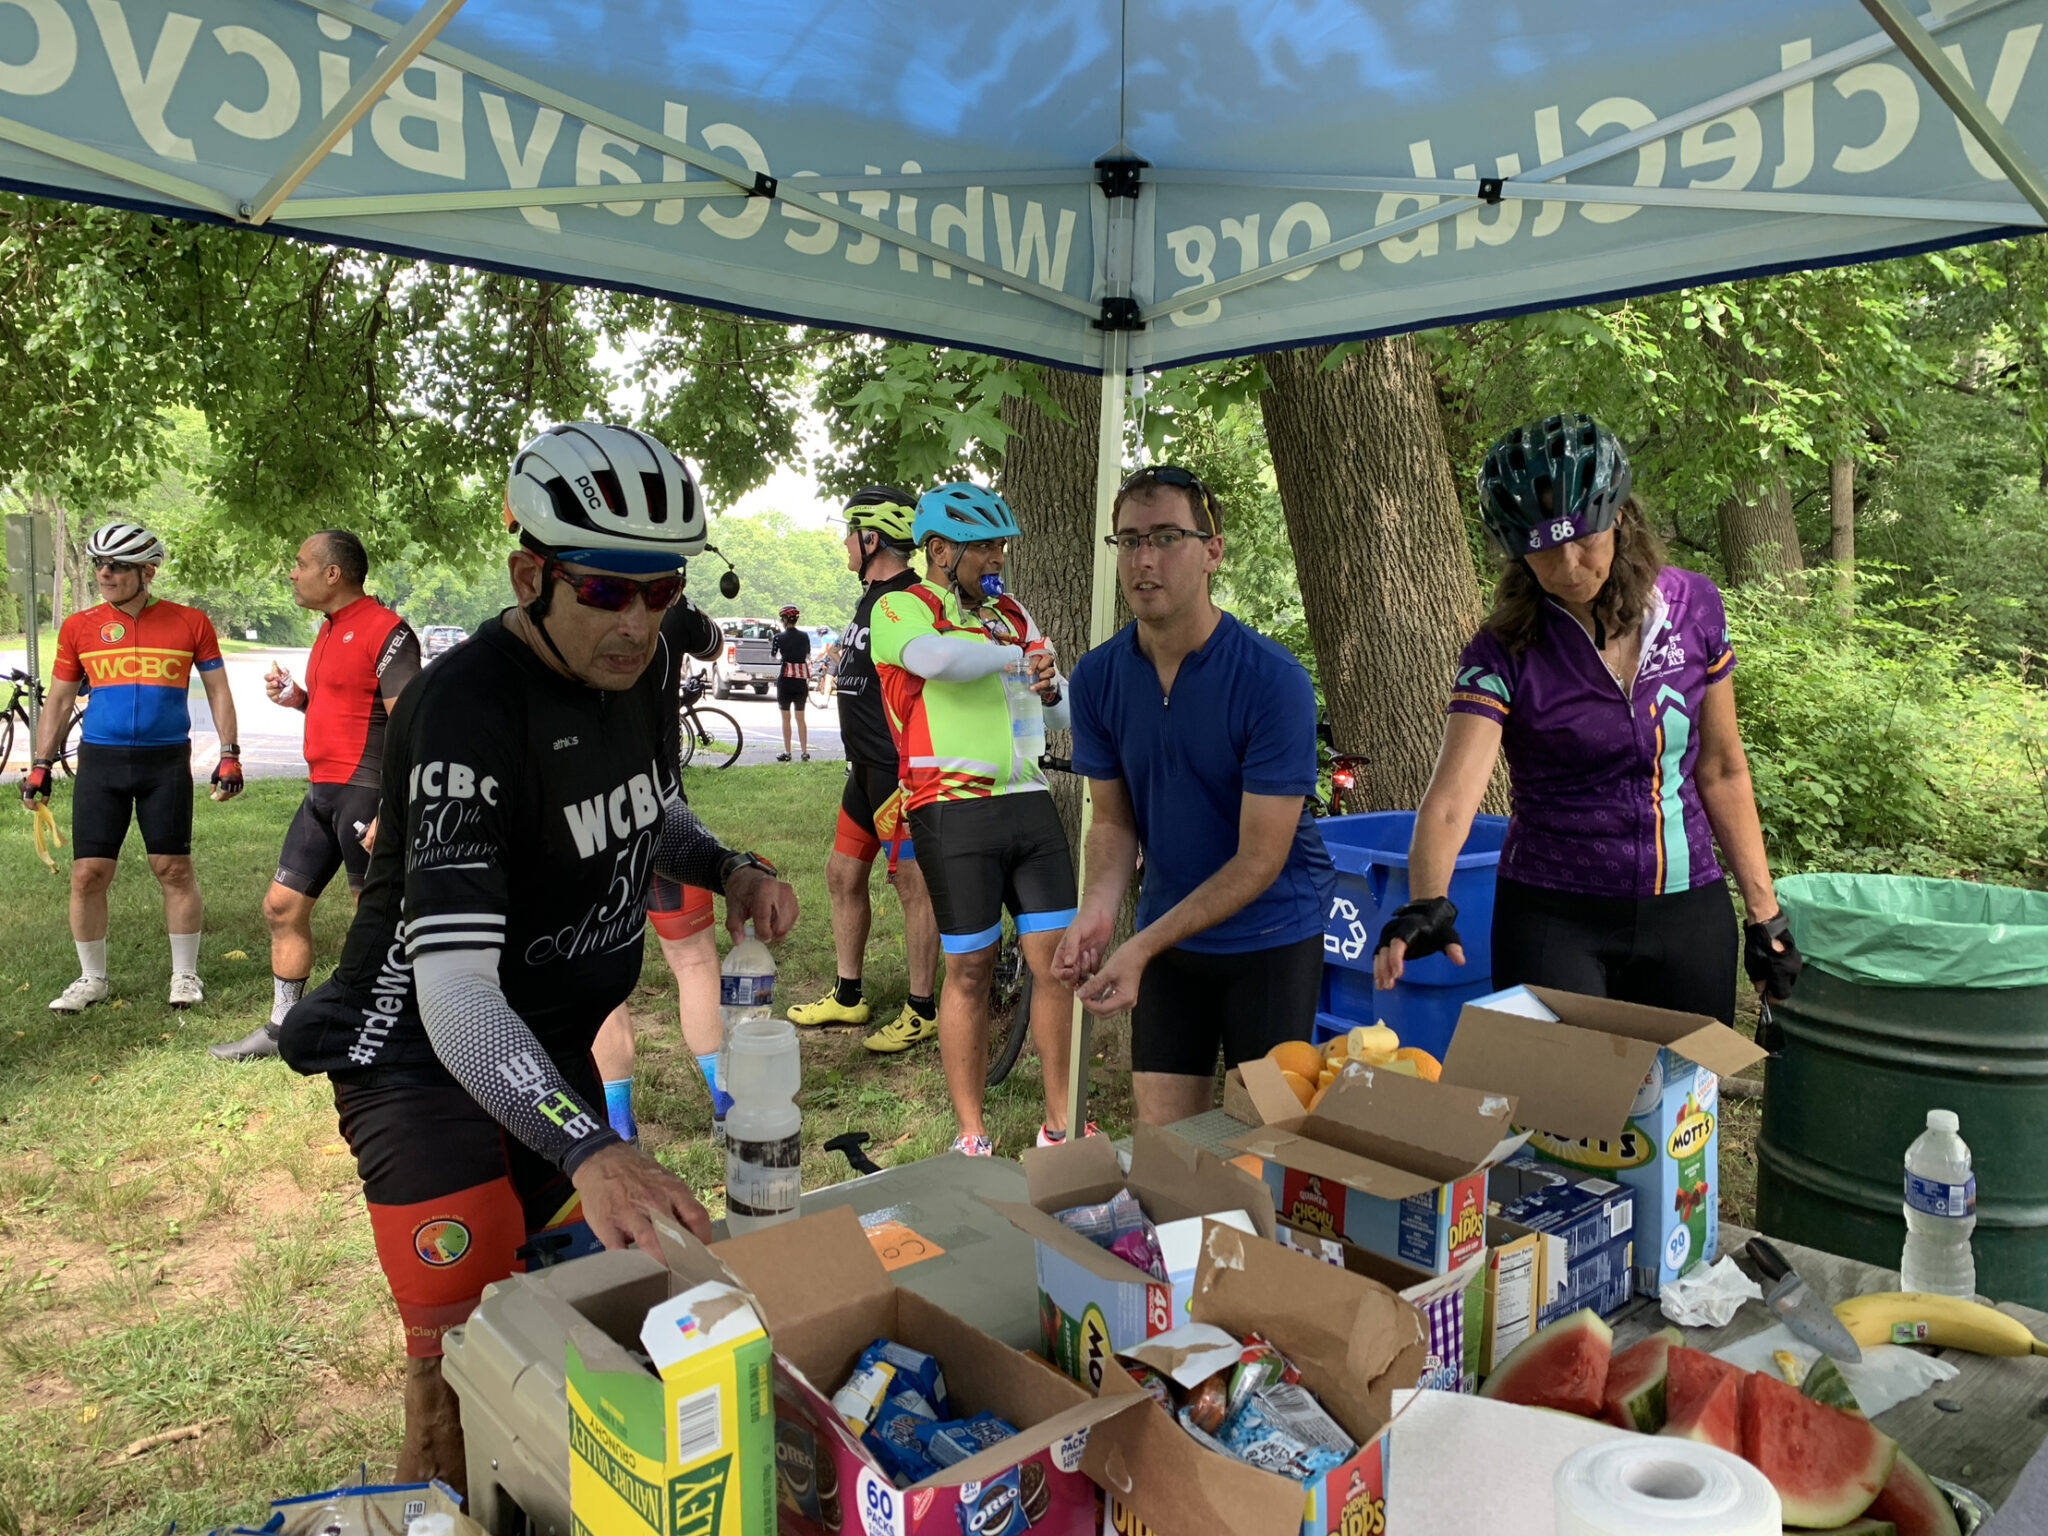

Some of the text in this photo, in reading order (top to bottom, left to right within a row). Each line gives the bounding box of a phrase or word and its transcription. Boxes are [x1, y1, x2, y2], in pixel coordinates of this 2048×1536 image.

[575, 475, 601, 510] POC
[1550, 521, 1575, 541] 86
[91, 656, 182, 680] WCBC
[1667, 648, 1685, 659] END
[1668, 656, 1686, 667] ALZ
[1672, 1119, 1710, 1152] MOTT'S
[1292, 1200, 1334, 1227] CHEWY
[1449, 1213, 1484, 1250] DIPPS
[1671, 1231, 1685, 1254] 90
[1153, 1287, 1168, 1331] 40
[1088, 1318, 1105, 1392] MO
[571, 1408, 612, 1481] VALLEY
[589, 1417, 636, 1470] CRUNCHY
[776, 1441, 814, 1471] OREO
[406, 1503, 423, 1514] 110
[611, 1461, 660, 1527] NATURE
[866, 1479, 894, 1521] 60
[970, 1486, 1019, 1531] OREO
[1340, 1489, 1371, 1518] CHEWY
